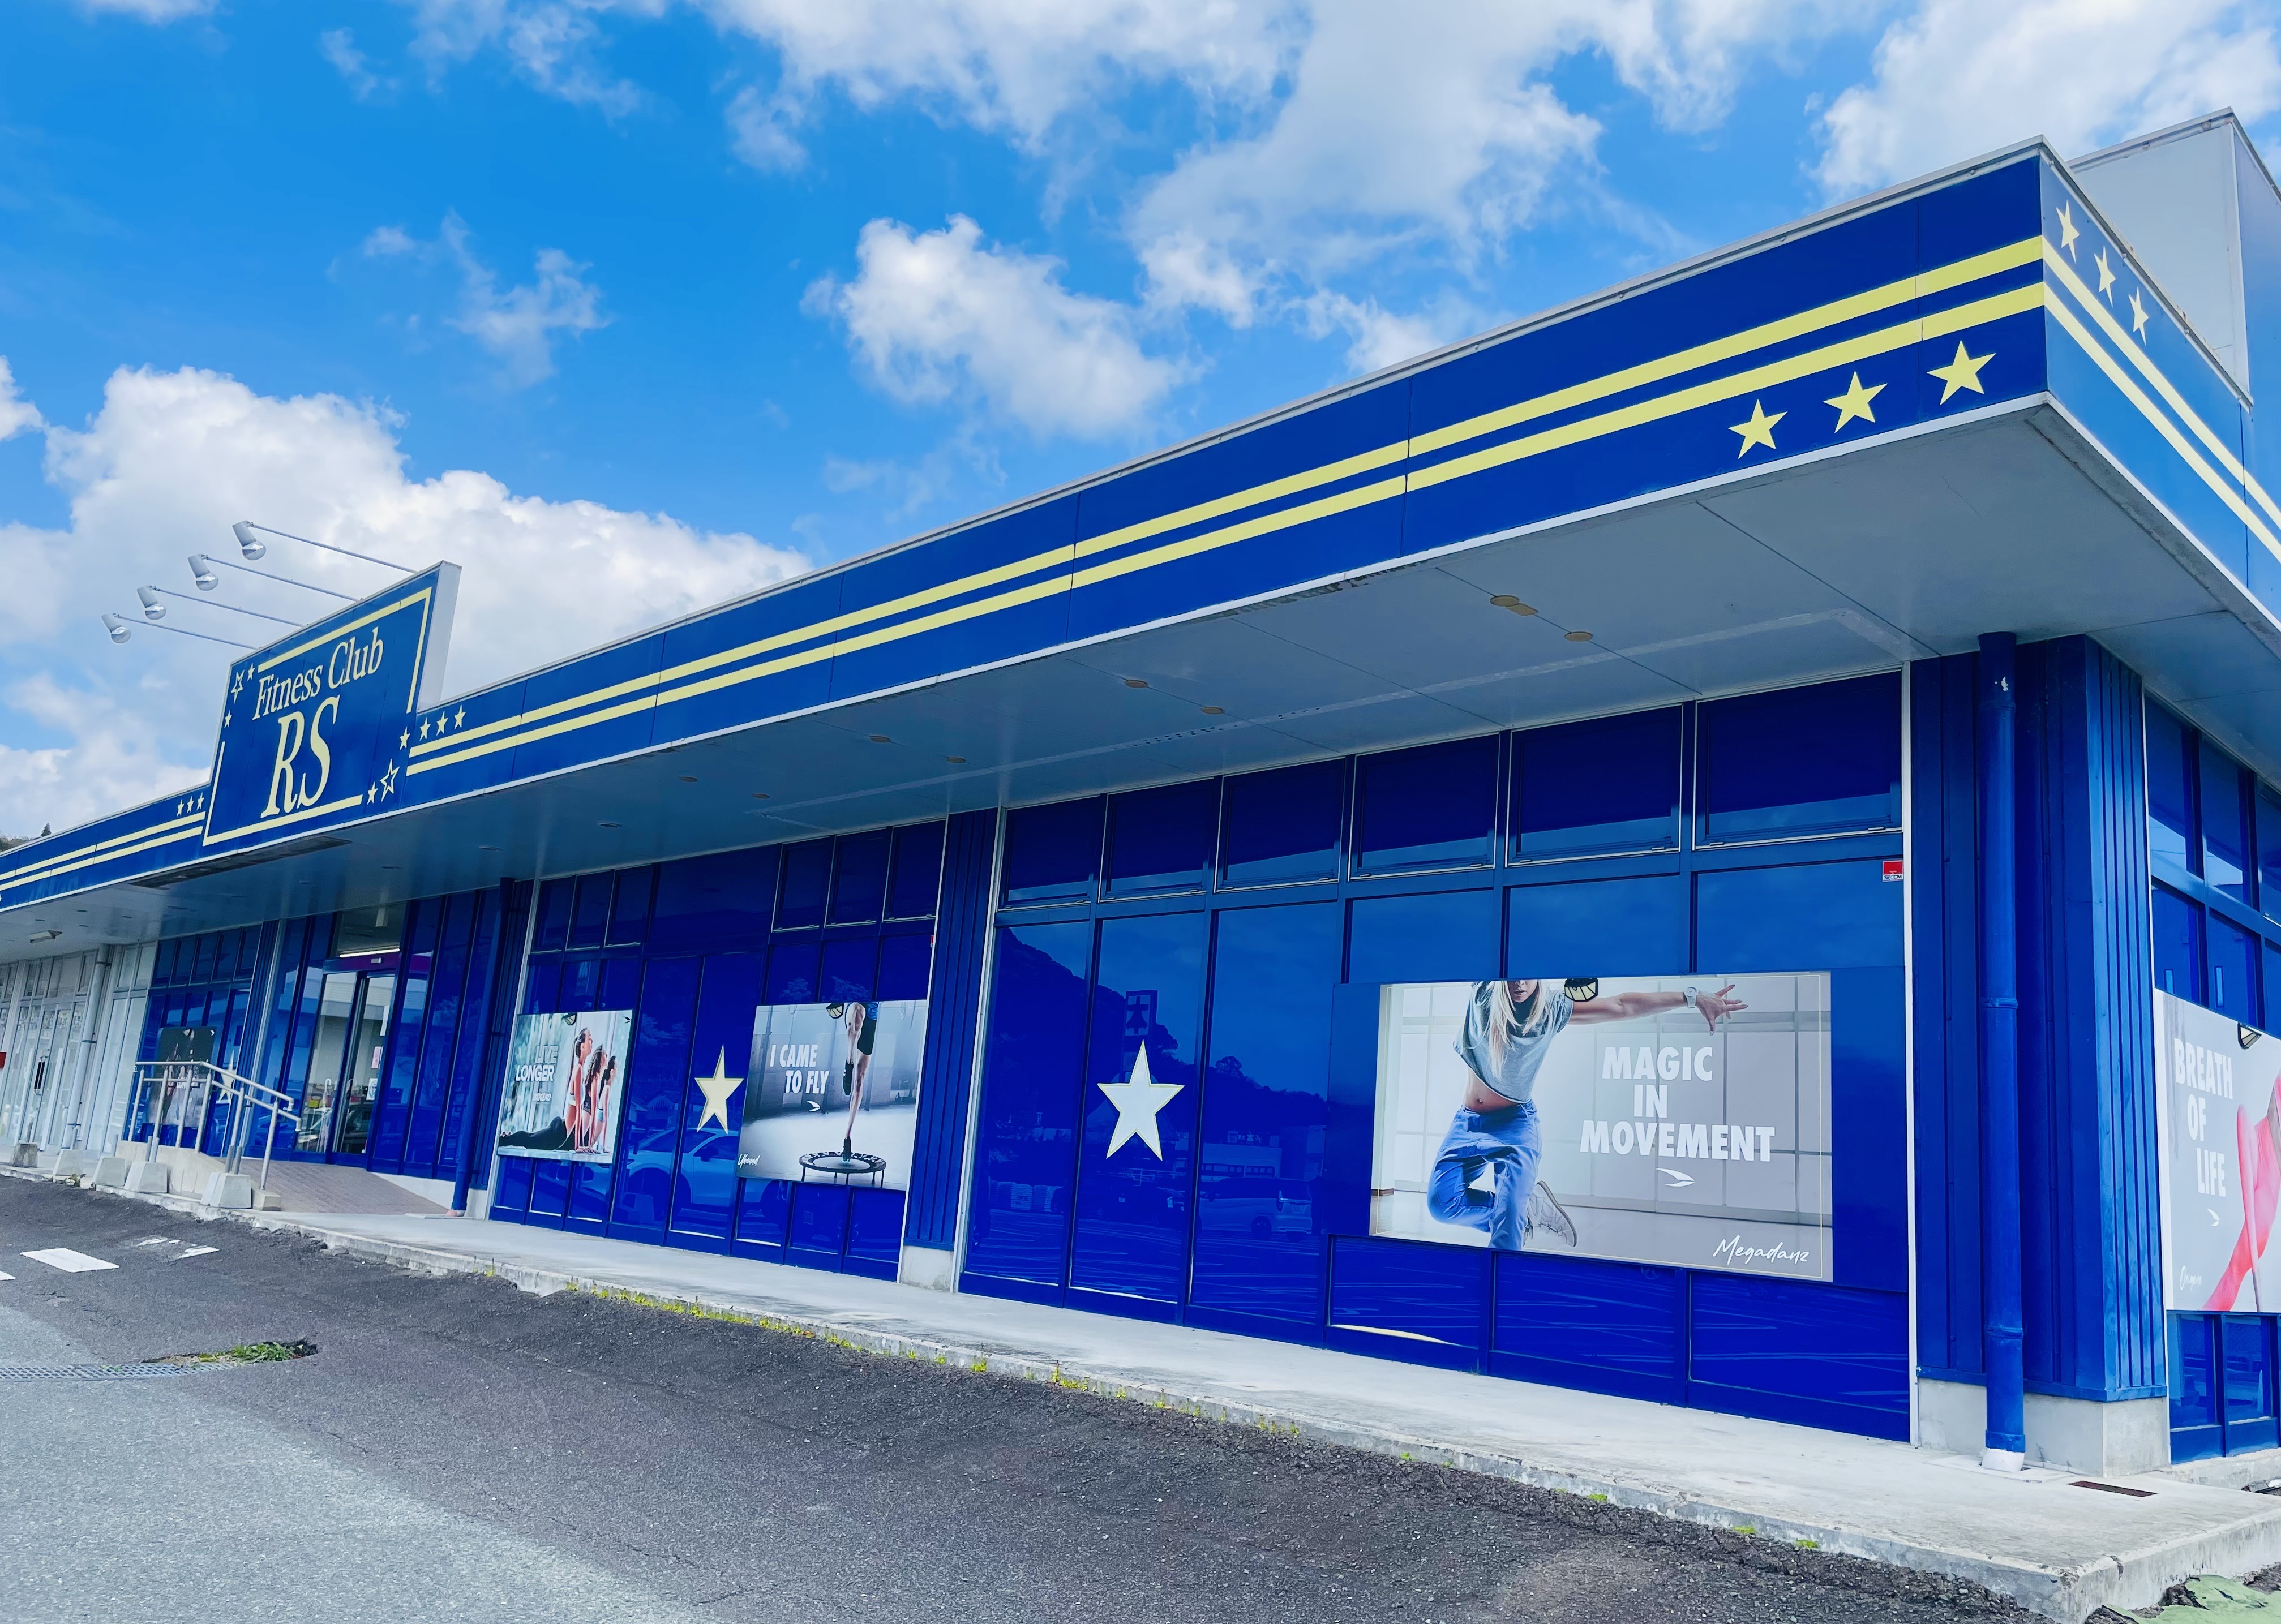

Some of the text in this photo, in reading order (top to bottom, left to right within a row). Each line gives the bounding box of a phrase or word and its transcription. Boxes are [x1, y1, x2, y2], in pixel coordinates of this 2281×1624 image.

[252, 626, 384, 721] Fitness Club
[260, 695, 340, 819] RS
[516, 1064, 555, 1081] LONGER
[535, 1046, 559, 1063] LIVE
[770, 1044, 818, 1068] I CAME
[1601, 1046, 1713, 1082] MAGIC
[2174, 1038, 2233, 1100] BREATH
[785, 1070, 830, 1094] TO FLY
[1633, 1084, 1668, 1119] IN
[2186, 1094, 2206, 1142] OF
[1579, 1120, 1776, 1162] MOVEMENT
[2196, 1148, 2226, 1197] LIFE
[1712, 1234, 1810, 1265] Megadanz
